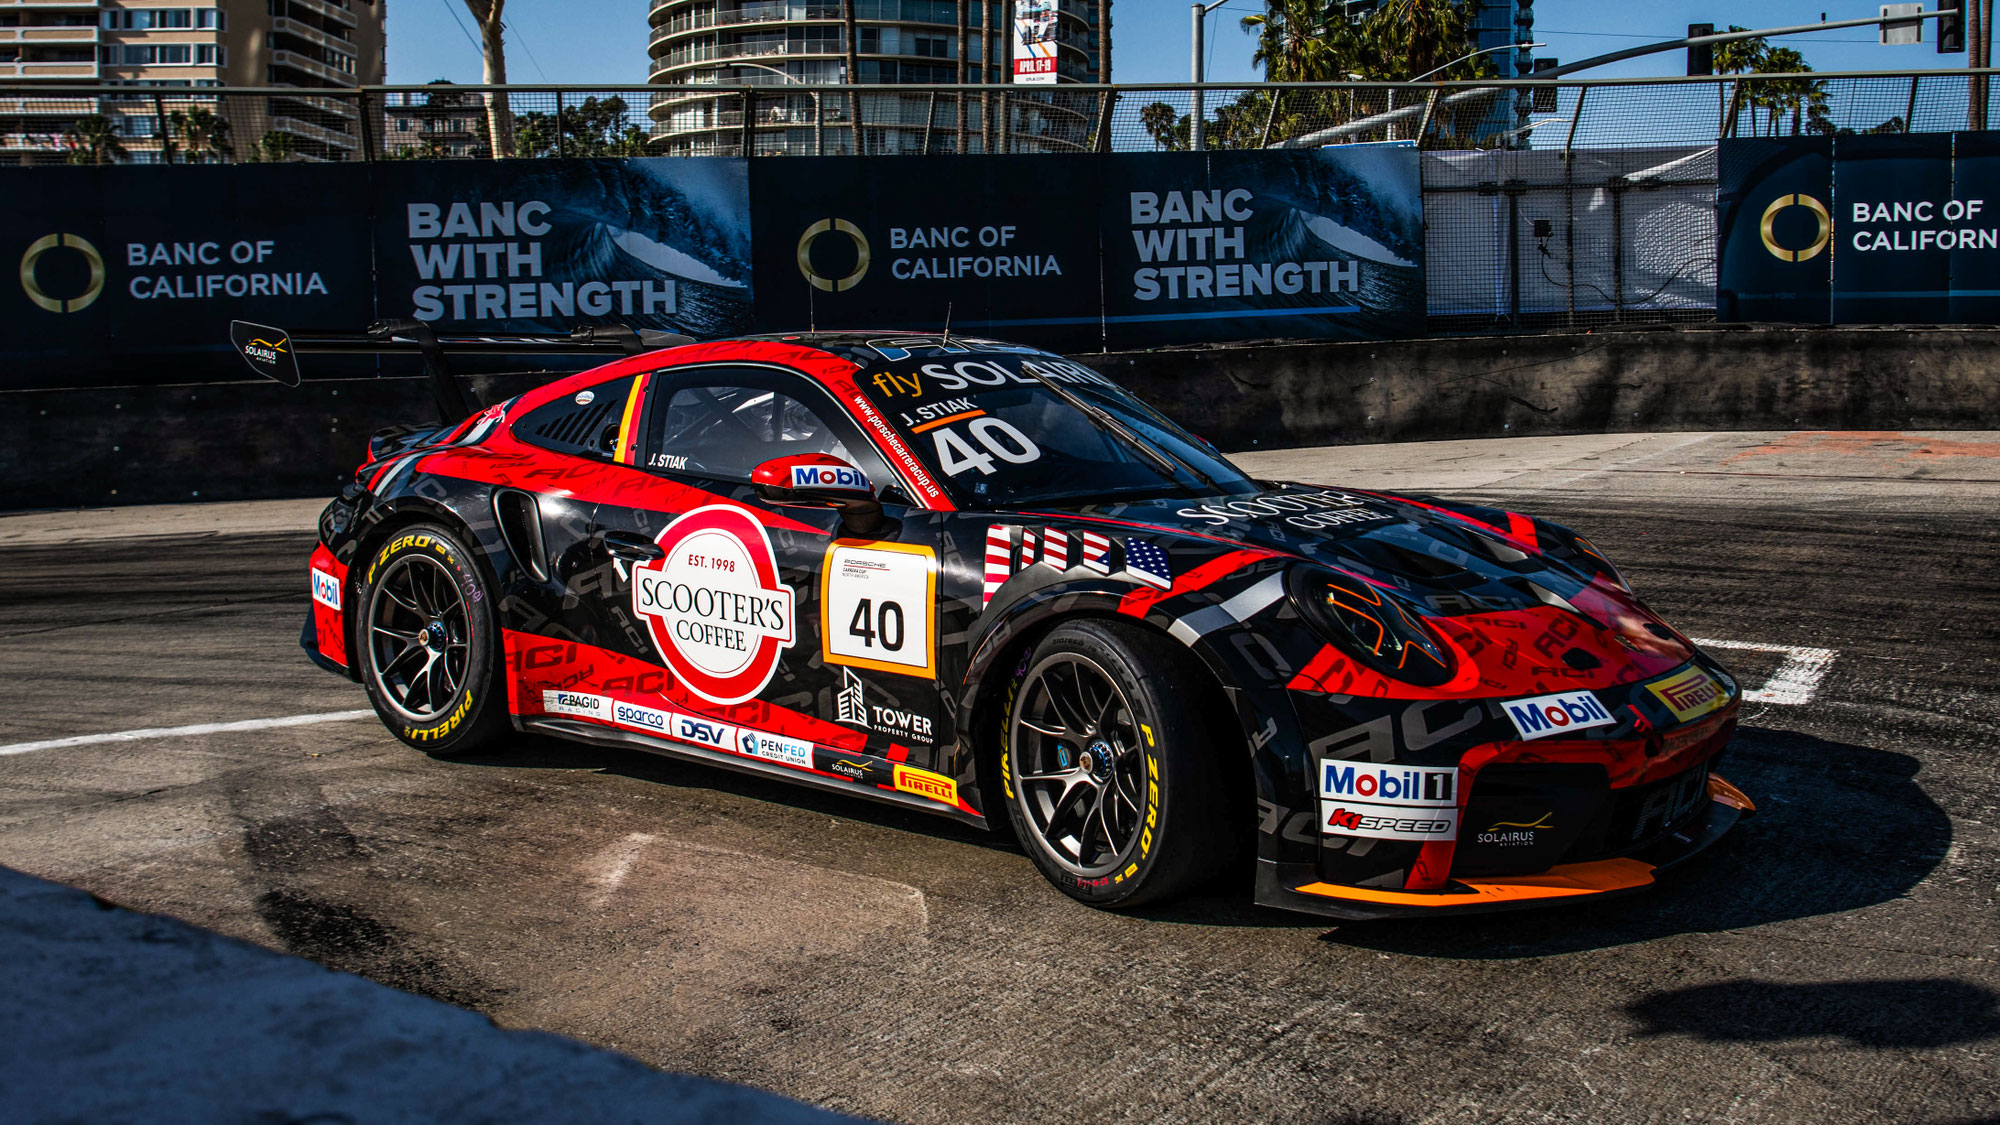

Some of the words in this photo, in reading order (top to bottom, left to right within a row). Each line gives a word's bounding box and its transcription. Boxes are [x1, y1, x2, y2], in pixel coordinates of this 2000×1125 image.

[407, 200, 552, 238] BANC
[1130, 188, 1254, 225] BANC
[1853, 202, 1934, 222] BANC
[1943, 200, 1983, 220] OF
[889, 227, 969, 249] BANC
[978, 225, 1017, 247] OF
[1132, 226, 1245, 260] WITH
[127, 242, 219, 266] BANC
[230, 240, 274, 264] OF
[409, 242, 543, 280] WITH
[891, 254, 1062, 280] CALIFORNIA
[129, 271, 328, 299] CALIFORNIA
[1133, 259, 1359, 301] STRENGTH
[412, 280, 678, 321] STRENGTH
[245, 345, 276, 360] SOLAIRUS
[901, 413, 921, 426] J.
[916, 397, 978, 419] STIAK
[854, 396, 939, 498] www.porschecarreracup.us
[932, 417, 1041, 477] 40
[649, 453, 658, 466] J.
[658, 454, 689, 470] STIAK
[796, 467, 867, 488] Mobil
[1286, 508, 1393, 528] COFFEE
[379, 534, 429, 567] ZERO
[688, 554, 707, 568] EST.
[711, 557, 735, 572] 1998
[844, 559, 886, 568] PORSCHE
[313, 573, 338, 605] Mobil
[642, 578, 784, 630] SCOOTER'S
[676, 620, 747, 651] COFFEE
[850, 598, 905, 651] 40
[569, 695, 599, 710] BAGID
[1659, 675, 1725, 713] PIRELLI
[411, 689, 473, 741] PIRELLI
[559, 707, 600, 717] RACING
[618, 706, 663, 726] sparco
[872, 706, 932, 735] TOWER
[1510, 694, 1606, 734] Mobil
[681, 719, 726, 746] DSV
[874, 724, 910, 738] PROPERTY
[911, 733, 933, 744] GROUP
[1002, 687, 1014, 799] PIRELLI
[1141, 723, 1155, 748] P
[761, 739, 806, 758] PENFED
[761, 751, 784, 761] CREDIT
[786, 756, 806, 765] UNION
[831, 763, 864, 776] SOLAIRUS
[1325, 765, 1419, 800] Mobil
[900, 771, 953, 799] PIRELLI
[1141, 756, 1159, 854] ZERO
[1477, 831, 1534, 845] SOLAIRUS
